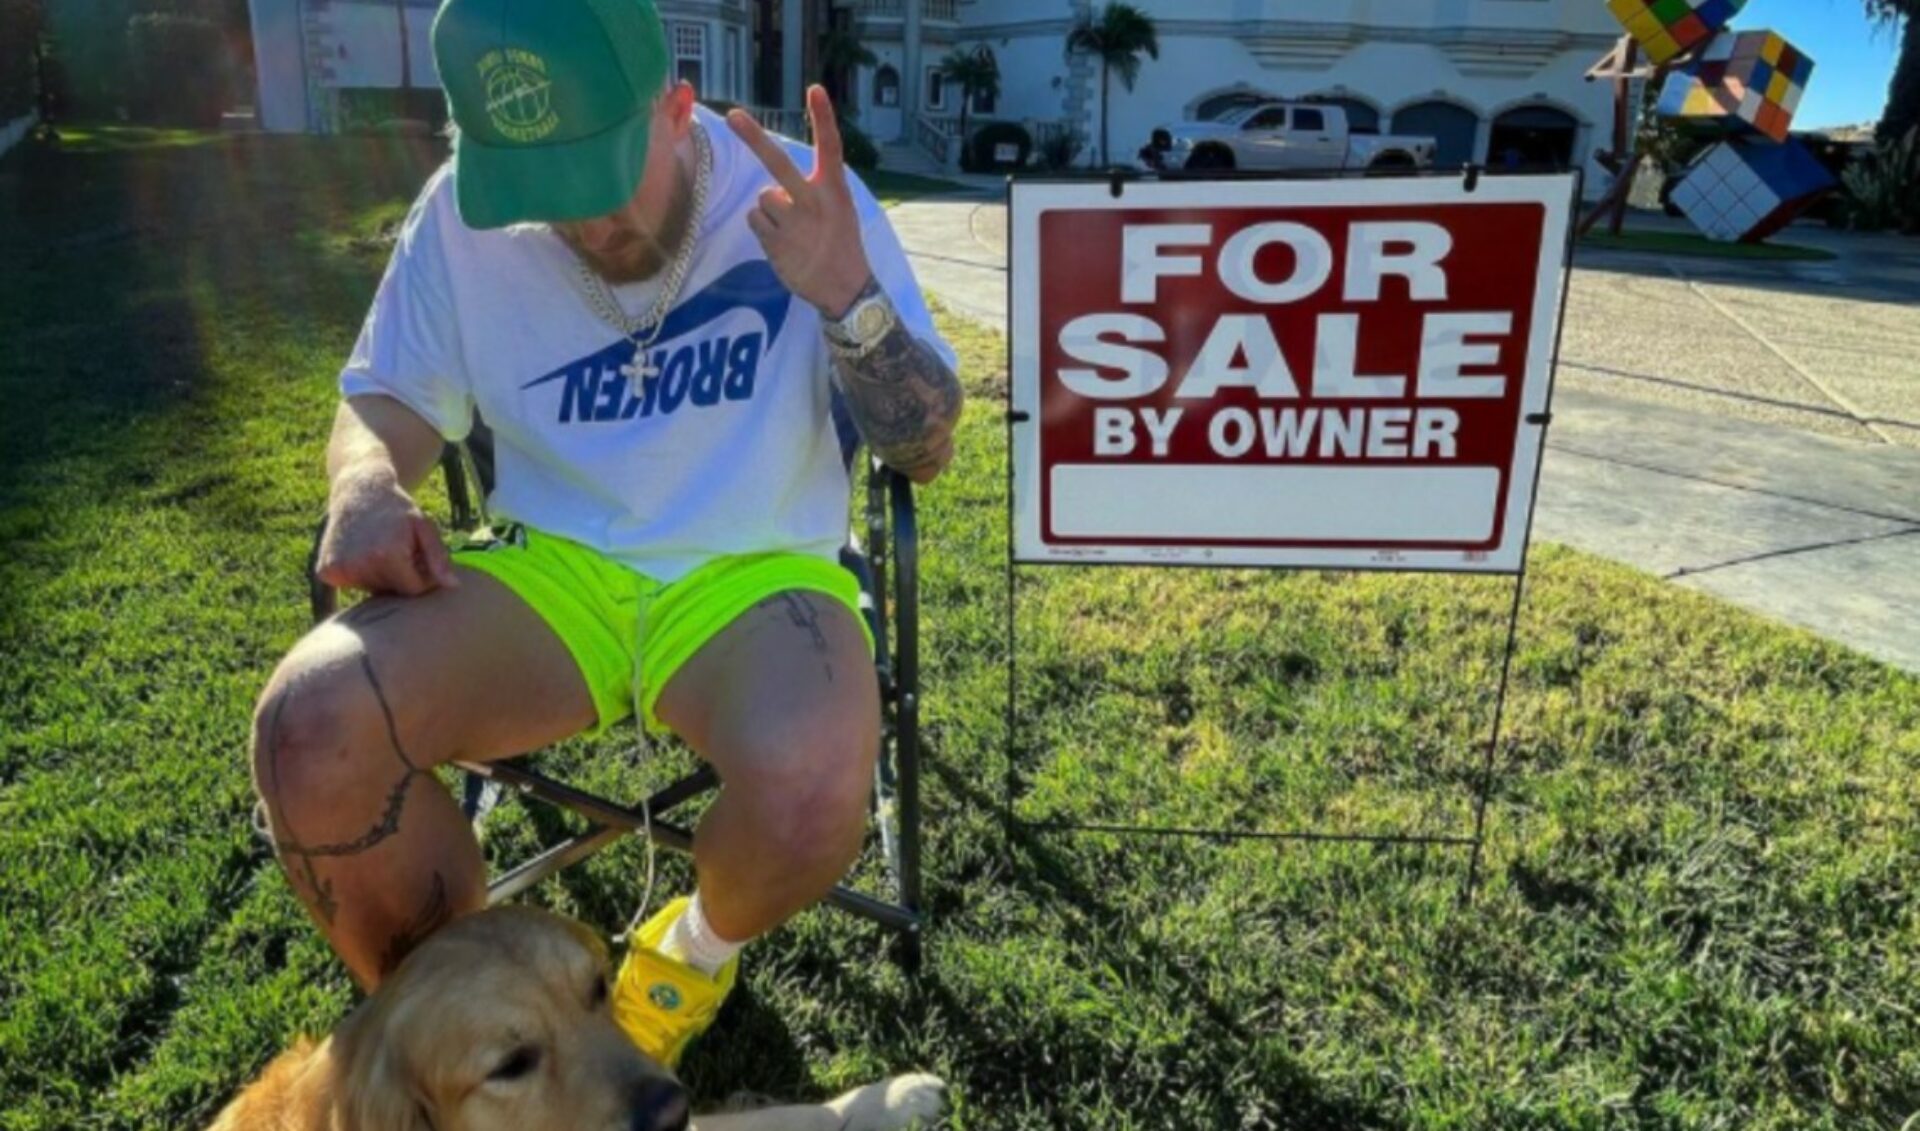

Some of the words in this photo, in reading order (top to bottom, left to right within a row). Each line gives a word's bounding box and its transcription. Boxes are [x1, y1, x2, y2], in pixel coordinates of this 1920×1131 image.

[1120, 221, 1453, 304] FOR
[558, 331, 763, 423] BROKEN
[1057, 311, 1513, 399] SALE
[1094, 407, 1183, 457] BY
[1208, 408, 1461, 458] OWNER
